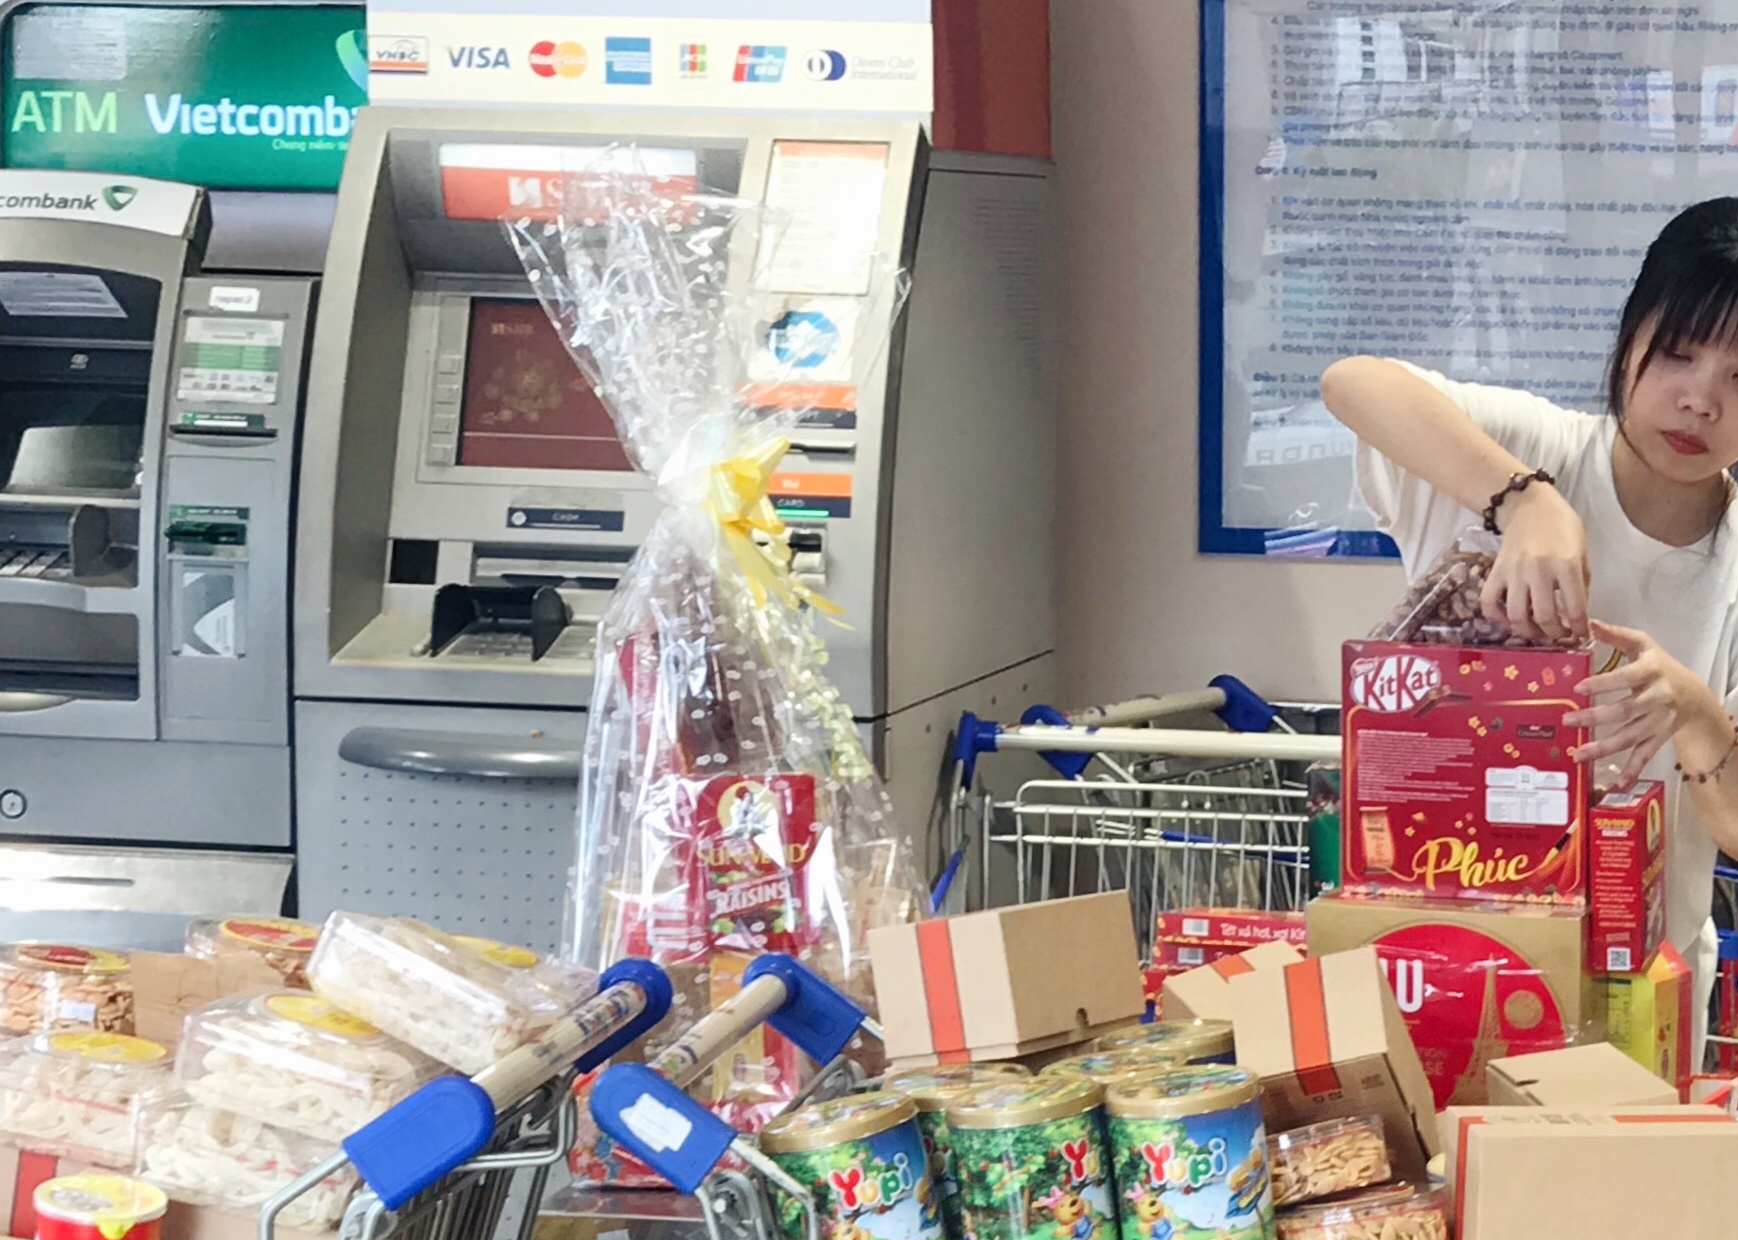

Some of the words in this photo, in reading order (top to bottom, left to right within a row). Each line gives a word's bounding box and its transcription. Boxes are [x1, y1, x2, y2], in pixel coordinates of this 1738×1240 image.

[446, 46, 511, 69] VISA
[12, 90, 118, 134] ATM
[144, 93, 360, 137] Vietcomb
[1360, 655, 1438, 712] KitKat
[1411, 836, 1532, 892] Phúc
[827, 1151, 915, 1210] Yupi
[1061, 1137, 1101, 1183] Yu
[1141, 1137, 1228, 1187] Yupi
